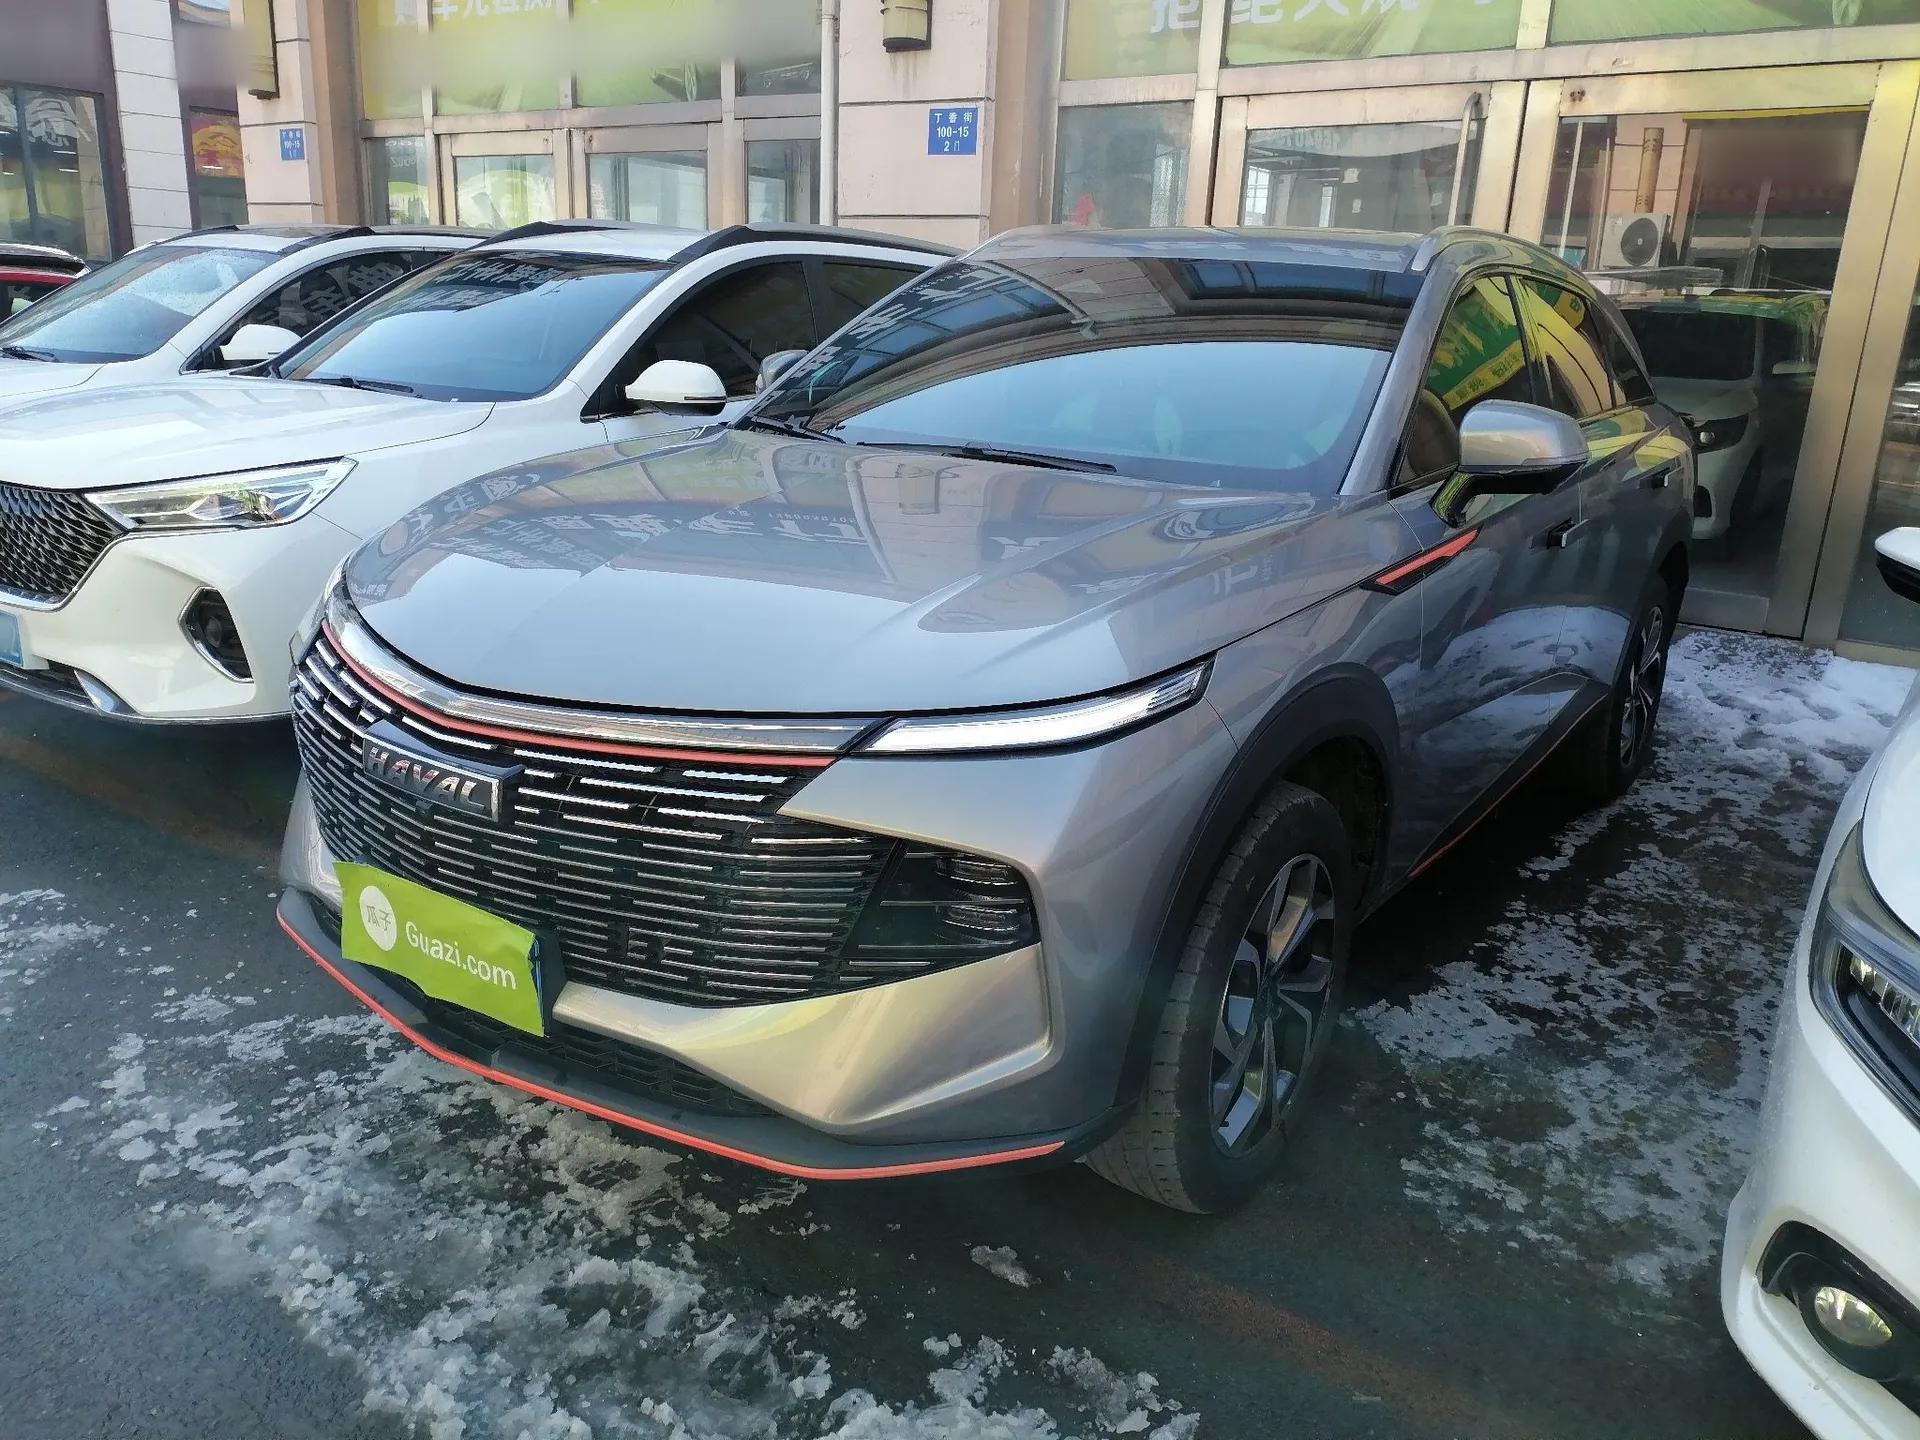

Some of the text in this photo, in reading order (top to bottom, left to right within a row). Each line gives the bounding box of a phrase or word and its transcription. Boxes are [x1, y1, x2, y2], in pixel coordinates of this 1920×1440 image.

[936, 126, 969, 138] 100-15
[367, 746, 485, 811] HAVAL
[366, 905, 392, 931] 瓜子
[405, 921, 517, 990] Guazi.com
